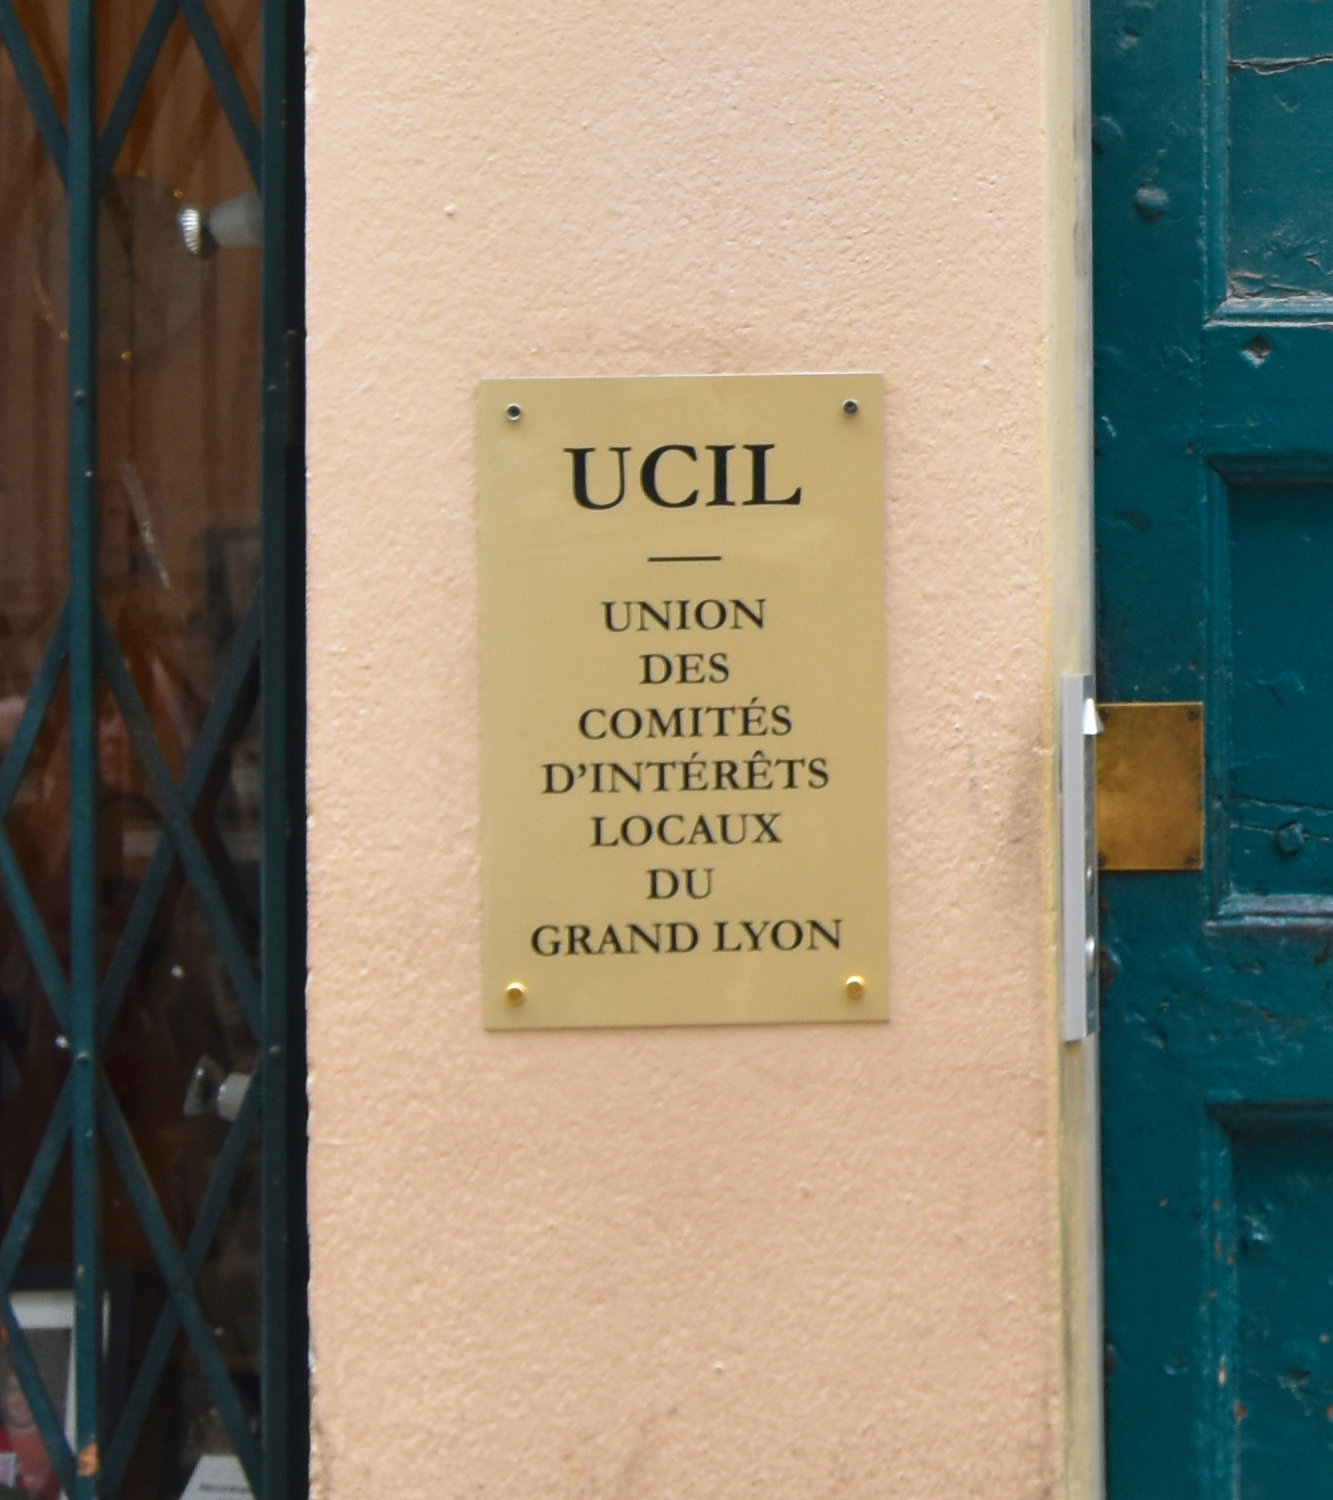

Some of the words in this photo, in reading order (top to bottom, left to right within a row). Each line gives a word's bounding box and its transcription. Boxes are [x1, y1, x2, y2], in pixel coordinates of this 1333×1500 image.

[564, 442, 803, 511] UCIL
[601, 597, 767, 633] UNION
[639, 651, 731, 686] DES
[577, 695, 793, 741] COMITÉS
[541, 748, 830, 795] D'INTÉRÊTS
[590, 812, 783, 848] LOCAUX
[645, 867, 715, 901] DU
[530, 921, 700, 957] GRAND
[713, 918, 844, 953] LYON
